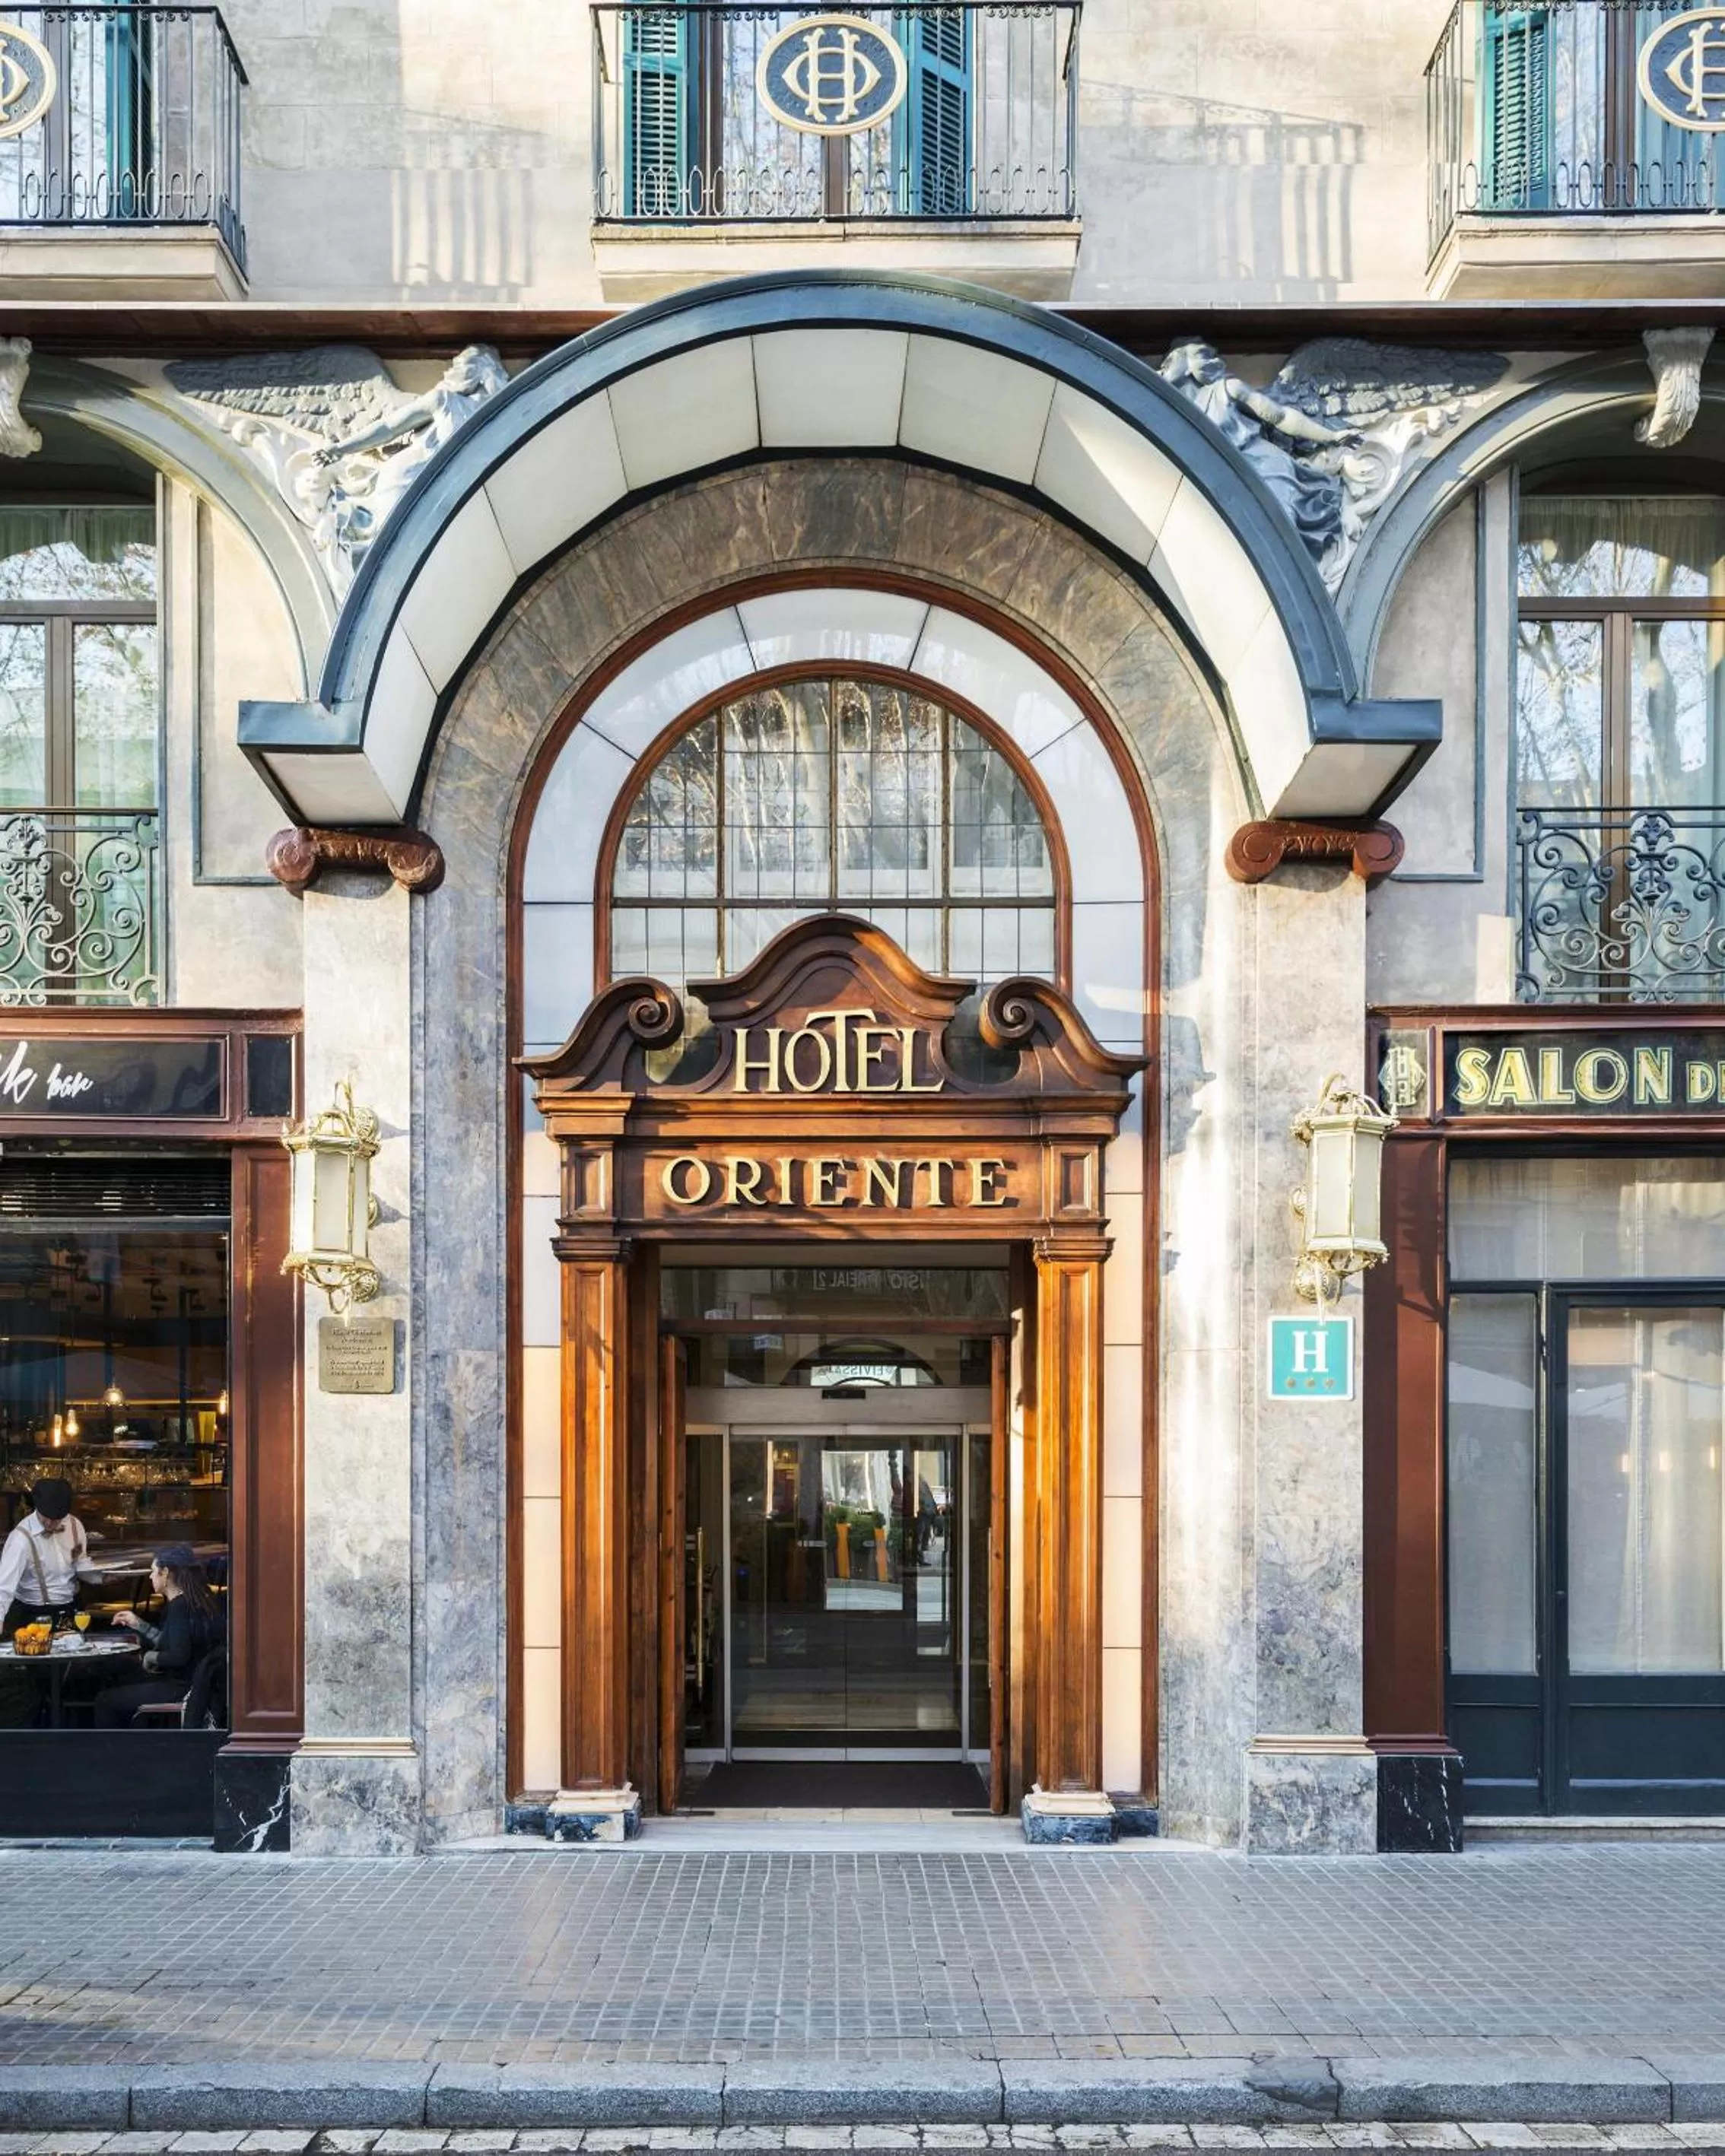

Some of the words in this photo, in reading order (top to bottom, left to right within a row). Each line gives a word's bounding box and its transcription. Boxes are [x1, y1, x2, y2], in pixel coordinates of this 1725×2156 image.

[733, 1008, 945, 1093] HOTEL
[1453, 1047, 1673, 1104] SALON
[46, 1062, 94, 1100] bar
[662, 1156, 1007, 1208] ORIENTE
[1291, 1330, 1329, 1373] H
